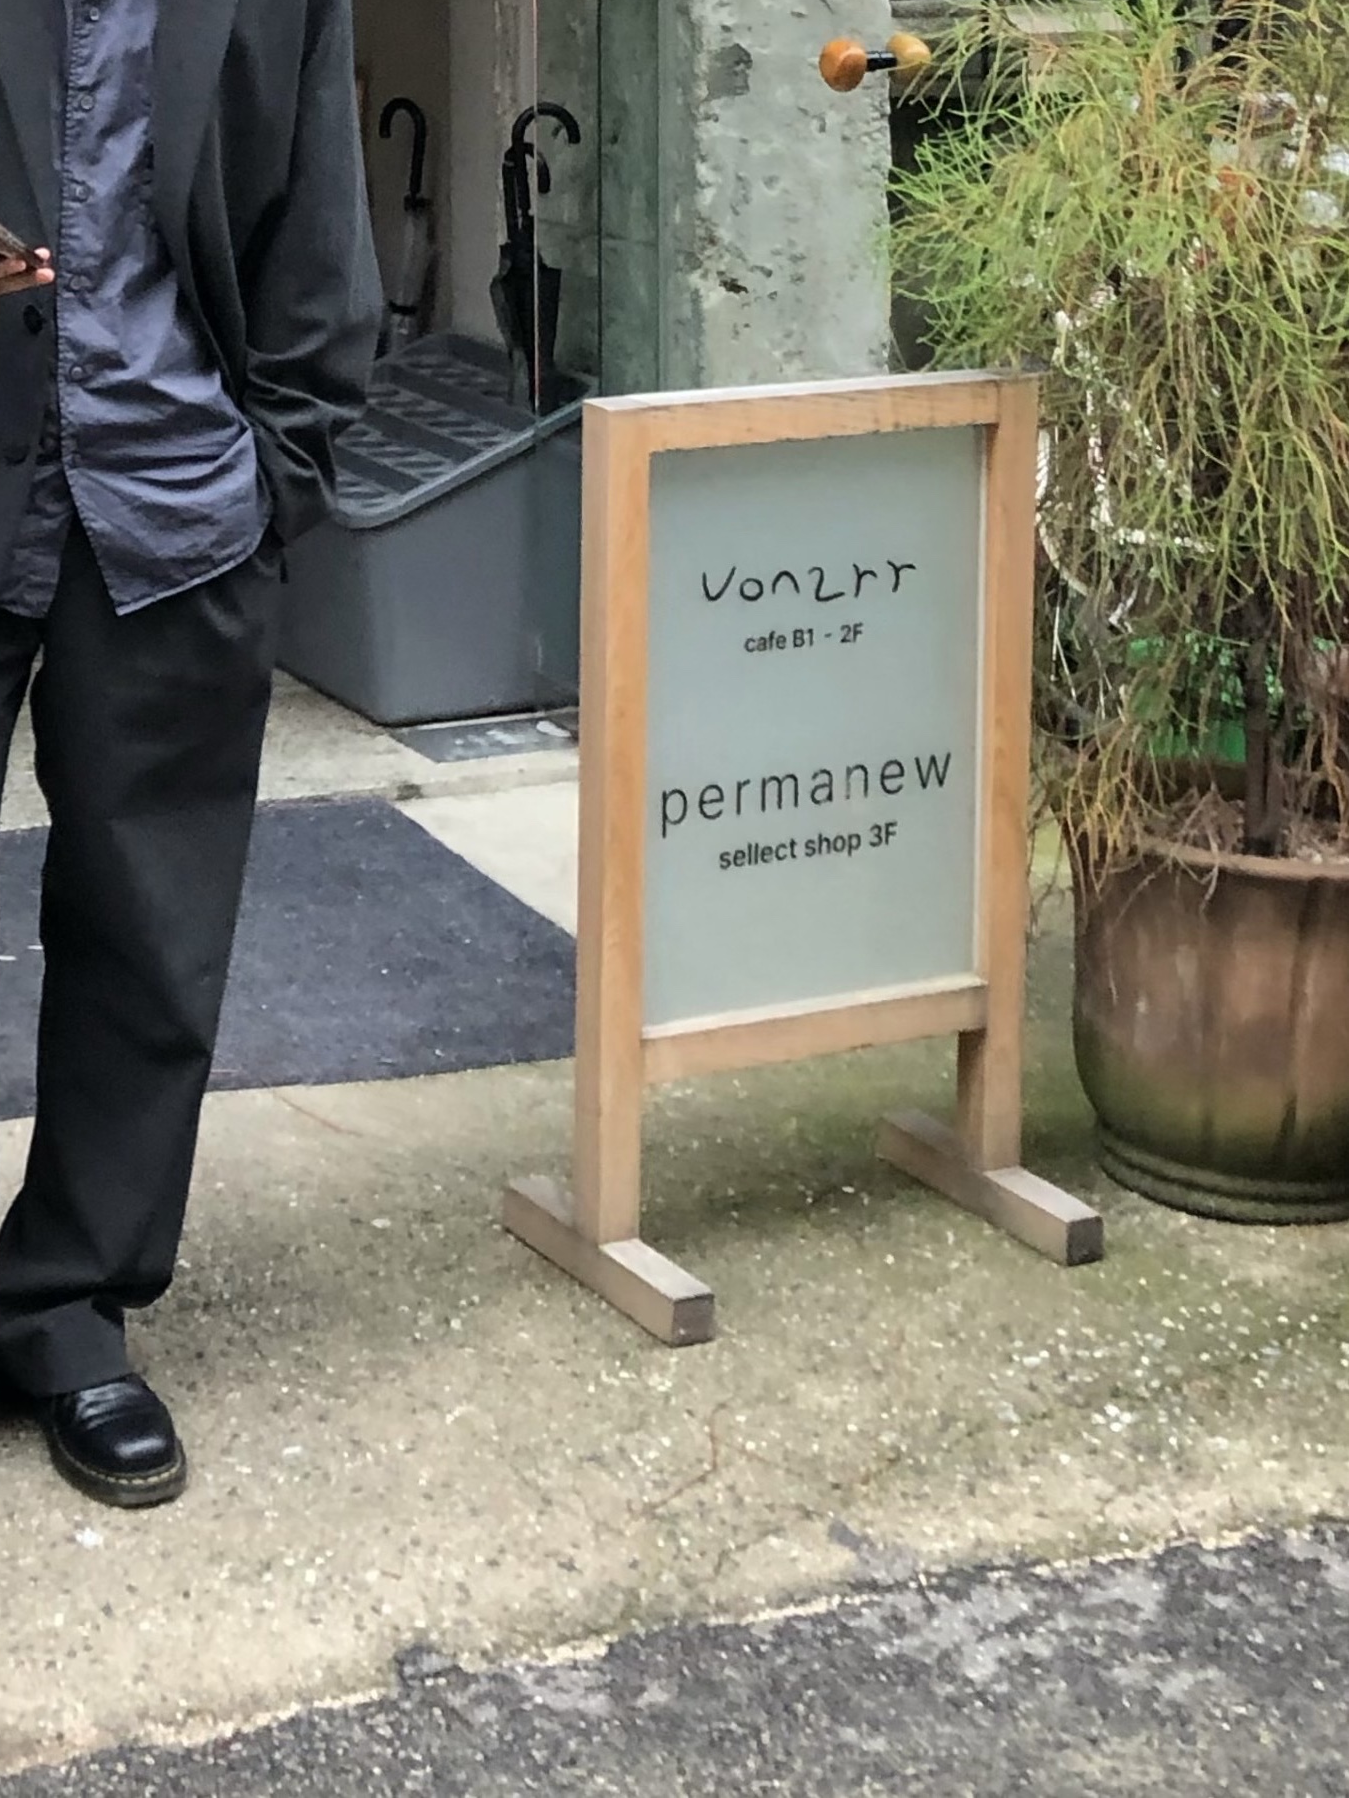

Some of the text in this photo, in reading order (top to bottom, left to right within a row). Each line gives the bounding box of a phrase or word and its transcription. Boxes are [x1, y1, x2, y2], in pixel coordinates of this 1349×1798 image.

[743, 630, 787, 653] cafe
[792, 628, 815, 649] B1
[839, 623, 864, 644] 2F
[661, 751, 951, 839] permanew
[718, 821, 899, 871] sellect shop 3F
